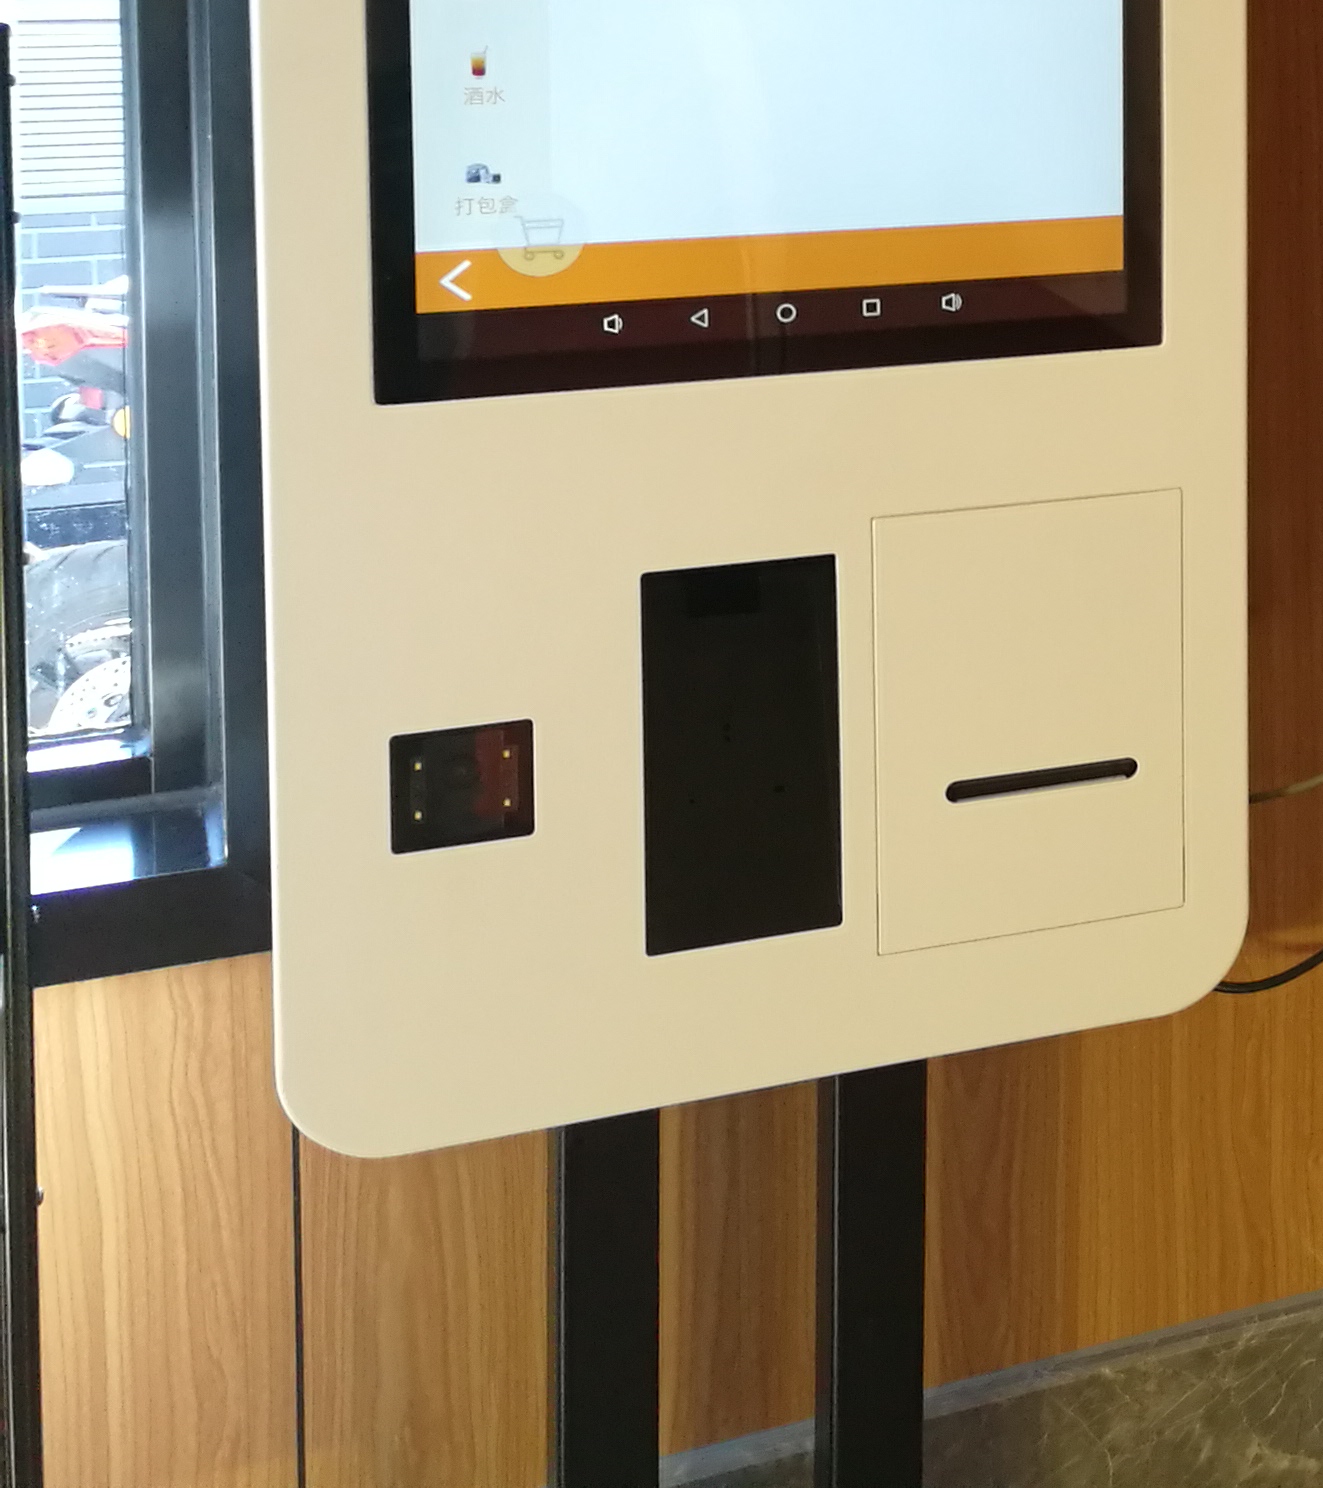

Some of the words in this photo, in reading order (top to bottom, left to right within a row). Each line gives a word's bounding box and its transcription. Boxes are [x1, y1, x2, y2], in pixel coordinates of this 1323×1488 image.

[464, 86, 506, 105] 酒水
[454, 195, 518, 216] 打包盒
